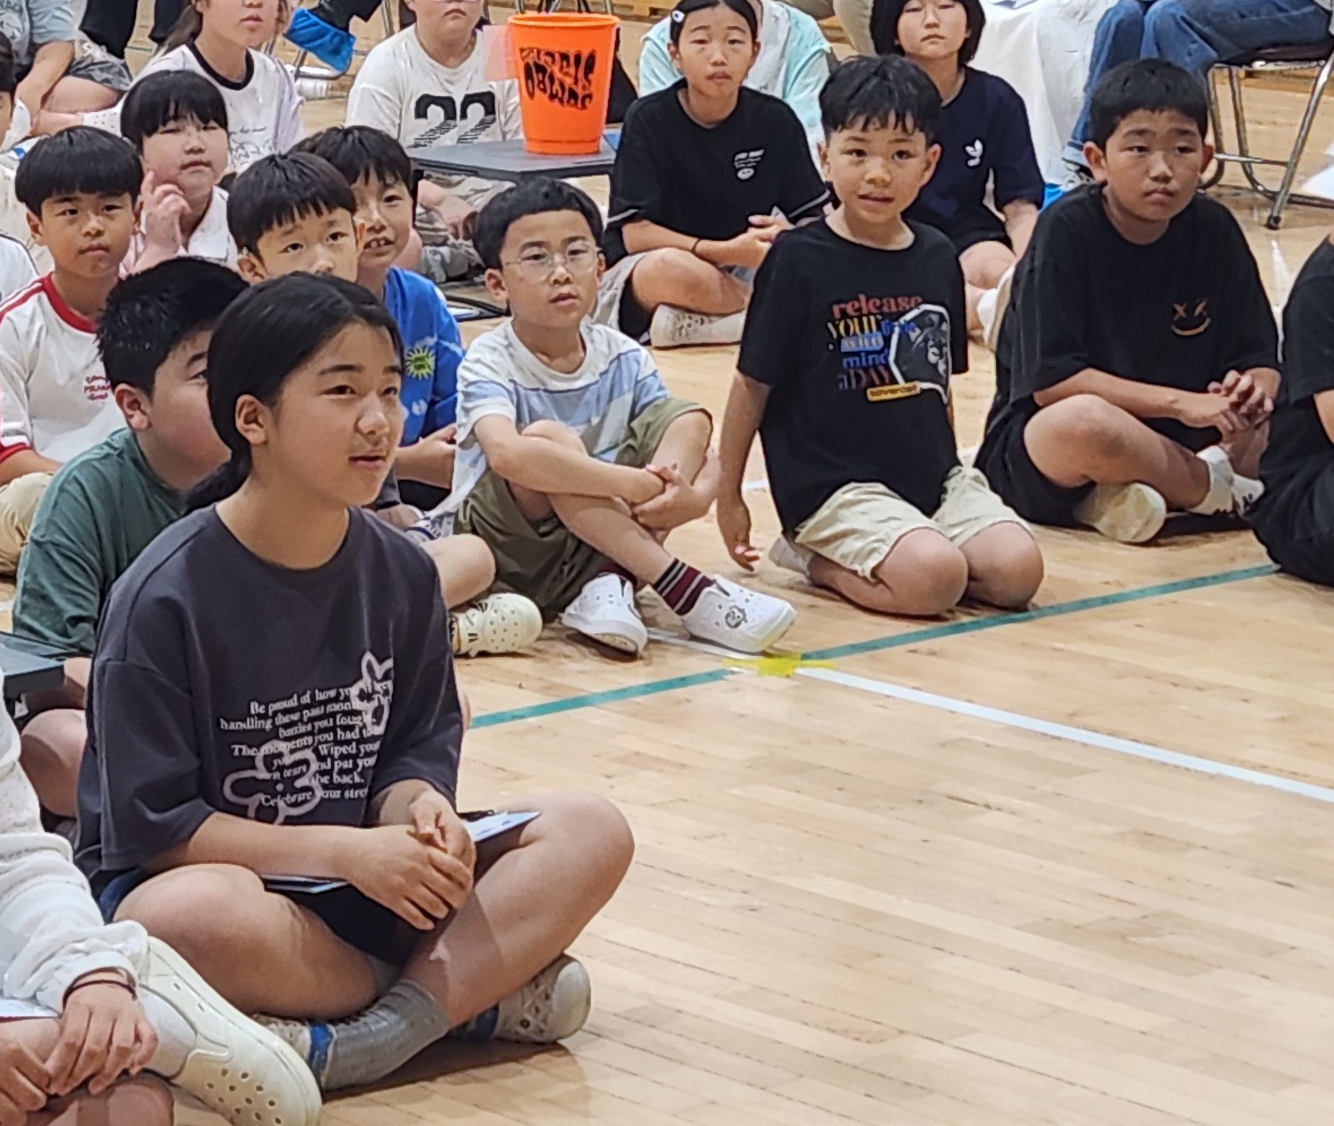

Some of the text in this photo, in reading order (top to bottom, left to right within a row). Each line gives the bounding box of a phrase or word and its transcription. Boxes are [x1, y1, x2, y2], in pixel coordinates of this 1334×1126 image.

[832, 293, 923, 319] release
[250, 701, 266, 714] Be
[268, 693, 298, 716] proud
[315, 688, 337, 701] how
[219, 716, 273, 732] handling
[231, 744, 258, 756] The
[314, 731, 333, 746] you
[337, 726, 360, 741] had
[318, 741, 357, 759] Wiped
